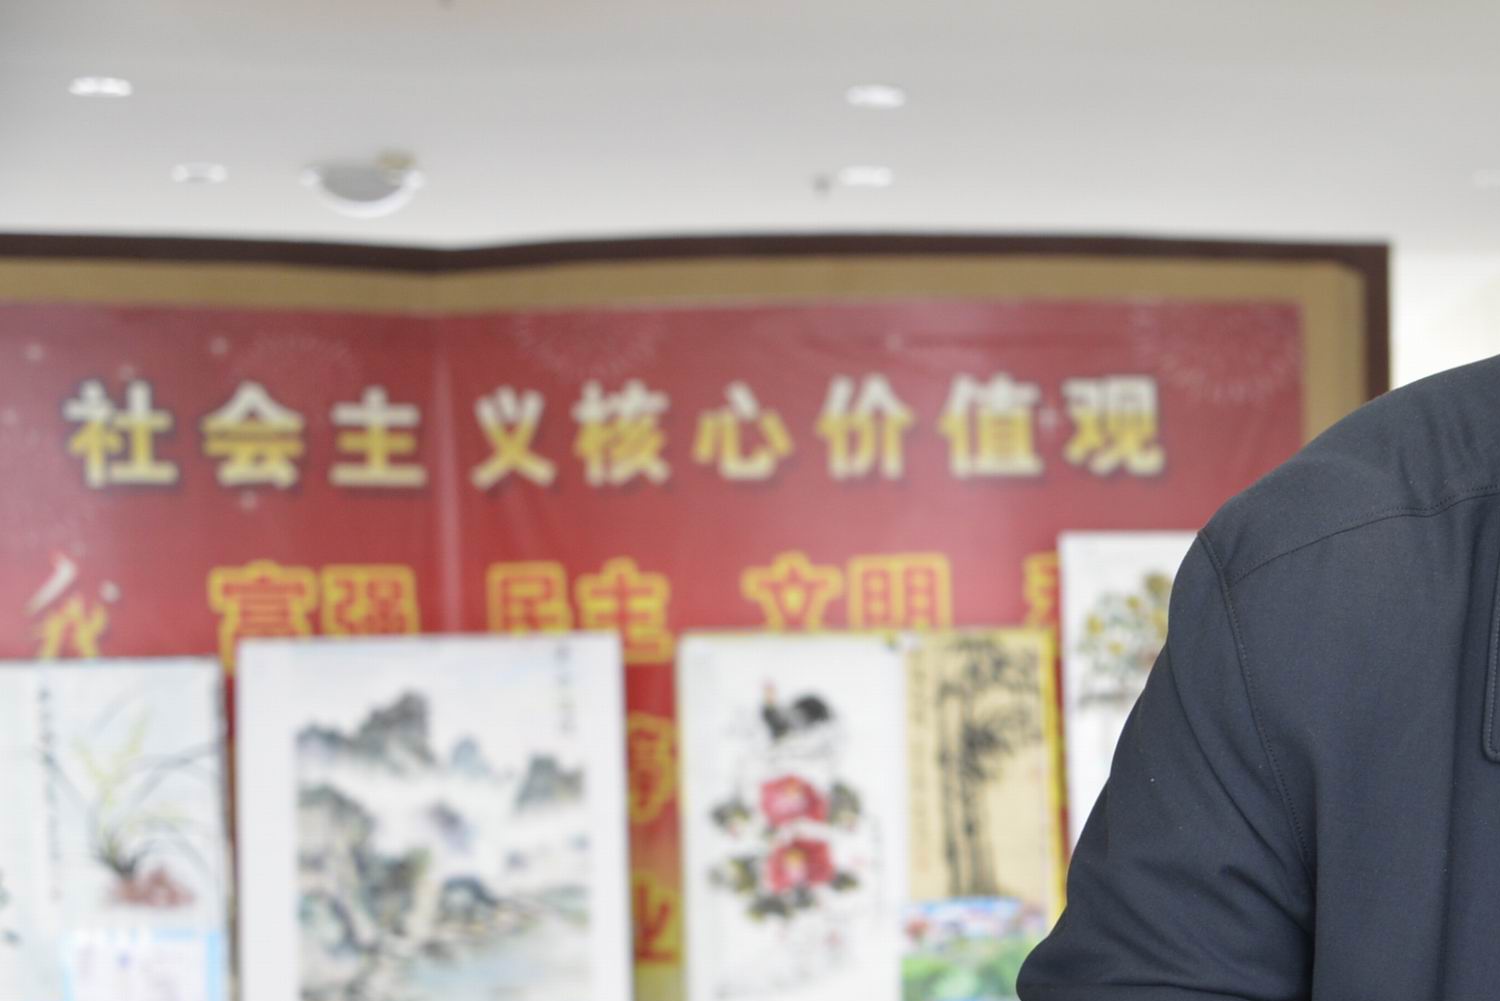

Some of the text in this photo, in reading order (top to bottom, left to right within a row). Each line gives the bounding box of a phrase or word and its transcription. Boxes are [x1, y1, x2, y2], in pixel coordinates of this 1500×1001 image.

[64, 374, 1166, 489] 社会主义核心价值观
